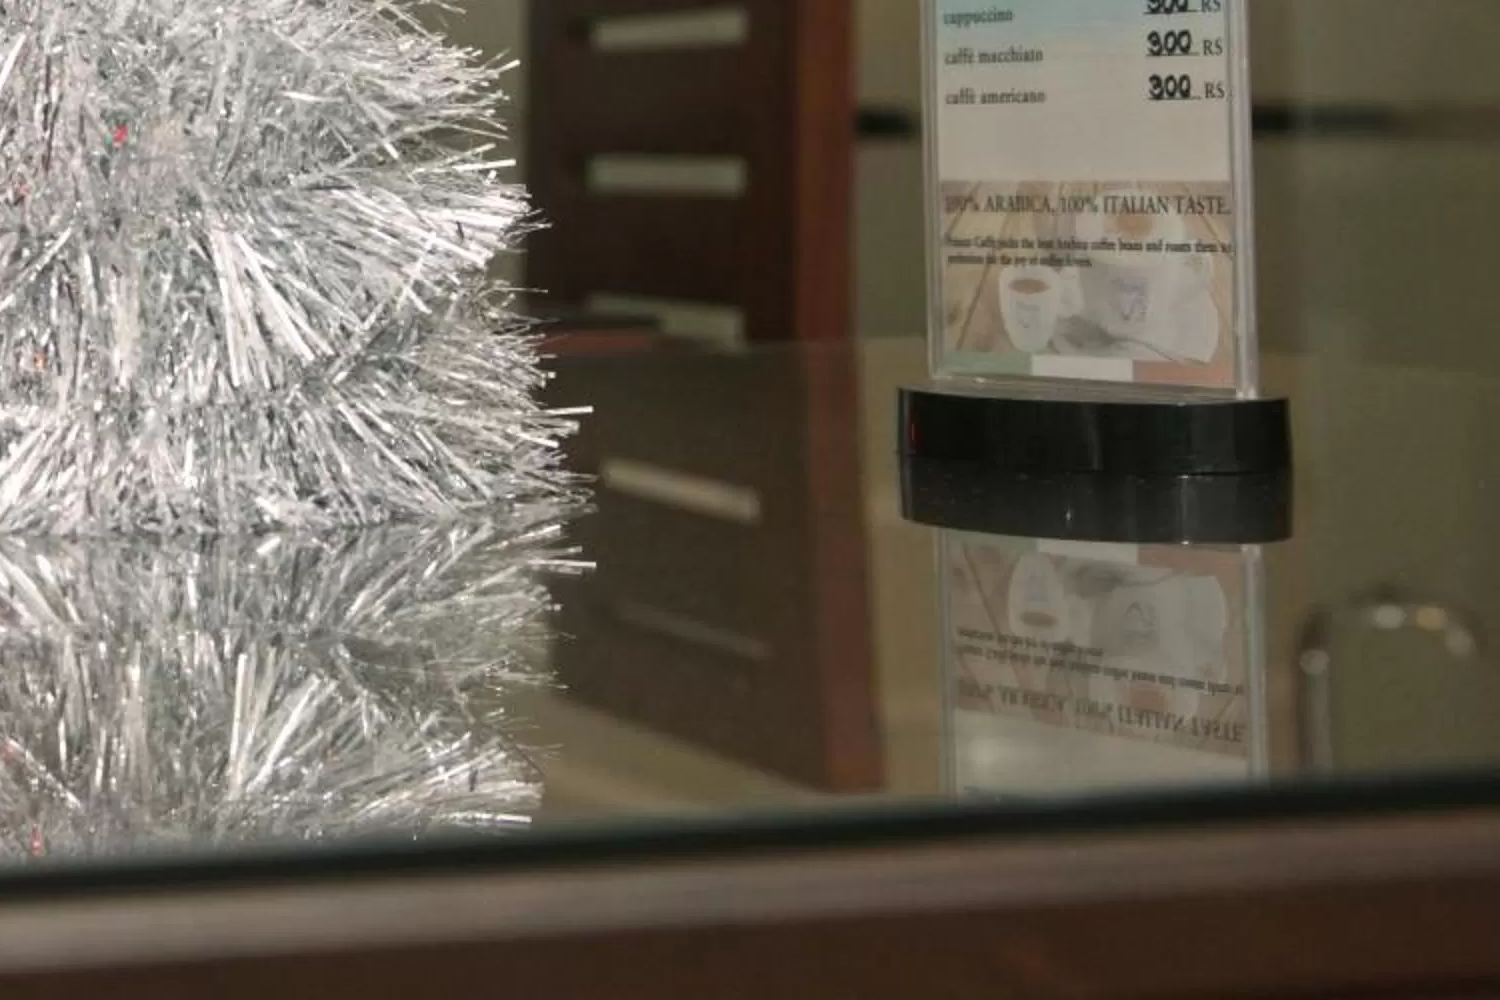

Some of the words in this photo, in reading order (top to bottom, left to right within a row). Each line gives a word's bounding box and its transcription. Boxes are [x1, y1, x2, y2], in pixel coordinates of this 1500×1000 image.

[1203, 37, 1223, 56] RS
[1148, 73, 1191, 100] 300
[1204, 81, 1225, 99] RS
[1103, 195, 1169, 214] ITALIAN
